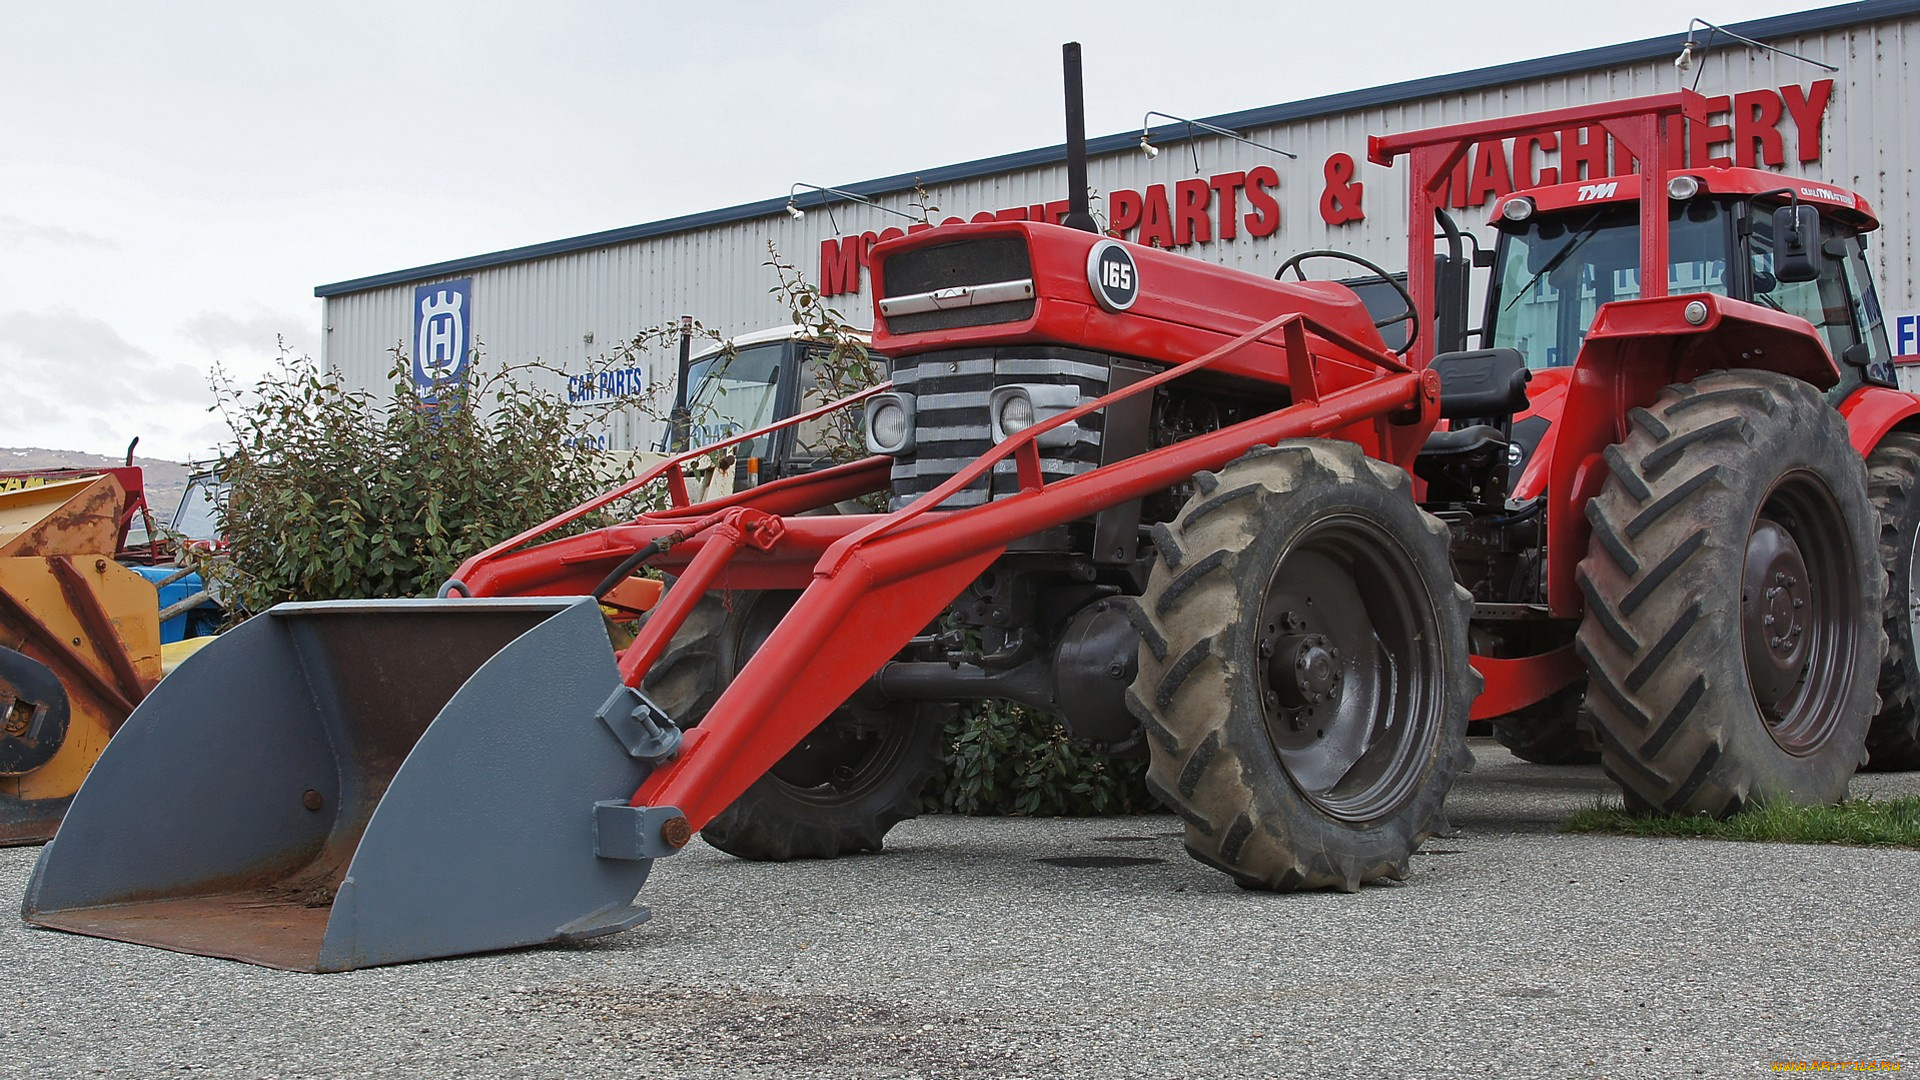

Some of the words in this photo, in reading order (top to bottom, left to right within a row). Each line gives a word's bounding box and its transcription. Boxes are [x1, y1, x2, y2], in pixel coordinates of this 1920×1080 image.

[1109, 166, 1280, 247] PARTS
[1319, 153, 1366, 225] &
[1432, 79, 1834, 211] ACHERY
[1578, 182, 1618, 201] TYM
[1103, 260, 1131, 290] 165
[569, 373, 595, 402] CAR
[600, 367, 641, 399] PARTS
